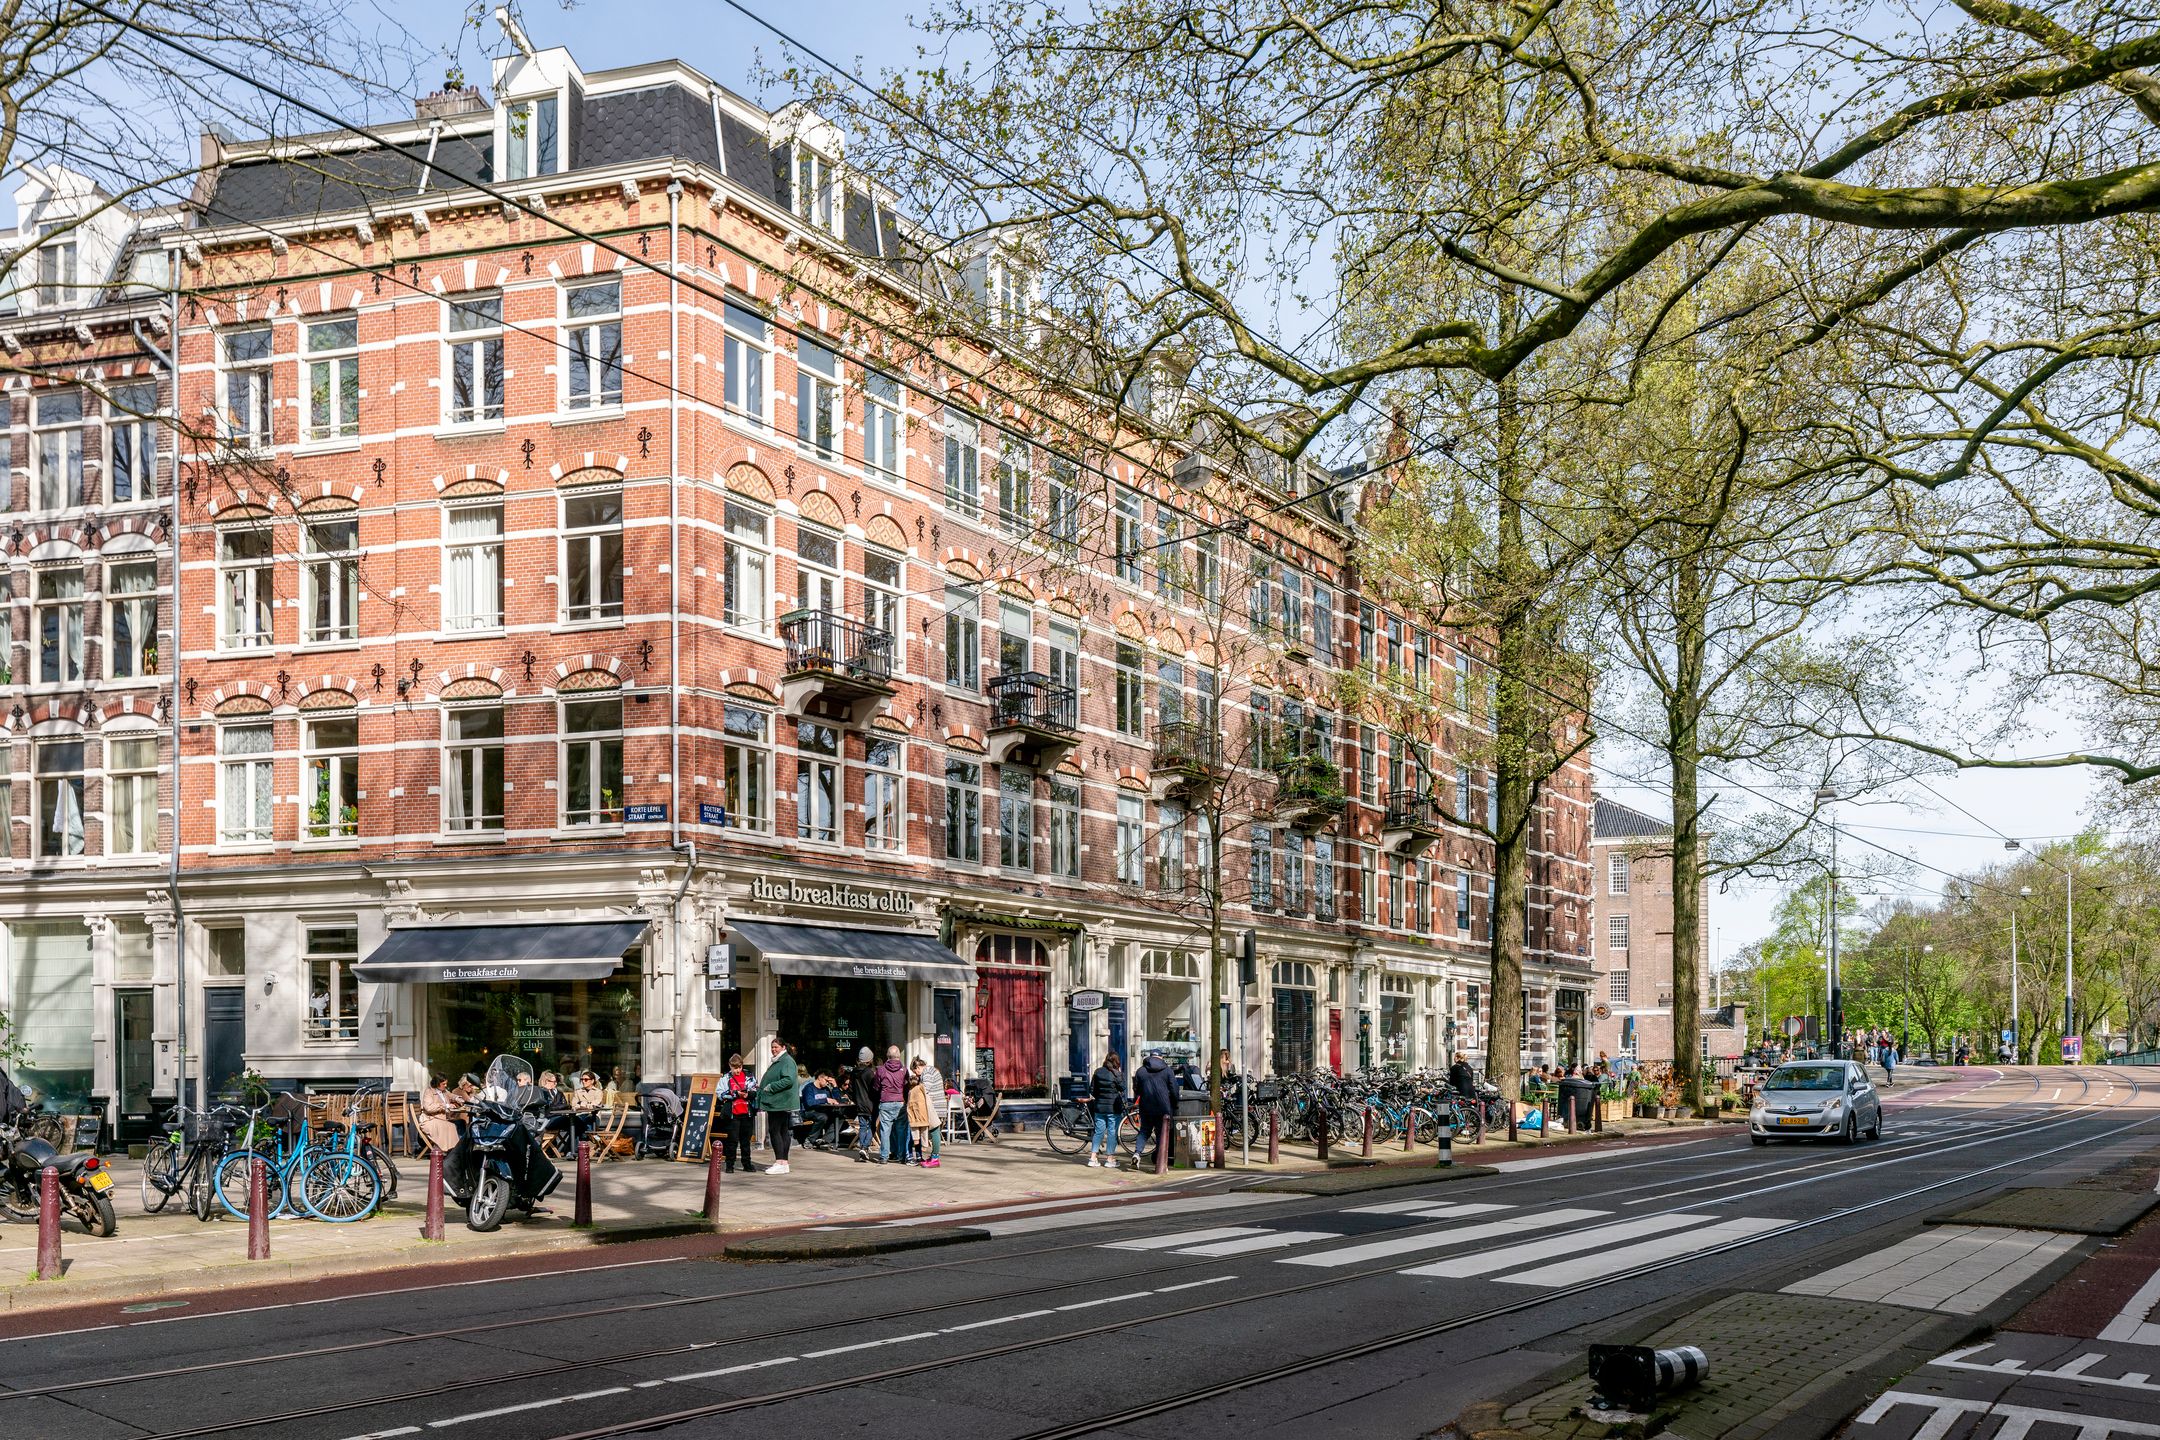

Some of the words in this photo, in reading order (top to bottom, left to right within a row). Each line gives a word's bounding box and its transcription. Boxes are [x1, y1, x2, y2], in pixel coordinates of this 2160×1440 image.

[703, 805, 722, 814] ROETERS
[703, 812, 719, 820] STRAAT
[752, 875, 786, 900] the
[789, 878, 878, 910] breakfast
[878, 890, 917, 913] club
[443, 968, 457, 978] the
[458, 967, 498, 977] breakfast
[498, 967, 519, 976] club
[853, 965, 864, 974] the
[864, 966, 892, 975] breakfast
[892, 967, 907, 976] club
[526, 1015, 540, 1025] the
[838, 1016, 848, 1025] the
[512, 1027, 554, 1037] breakfast
[828, 1027, 858, 1037] breakfast
[523, 1040, 543, 1049] club
[836, 1039, 851, 1048] club
